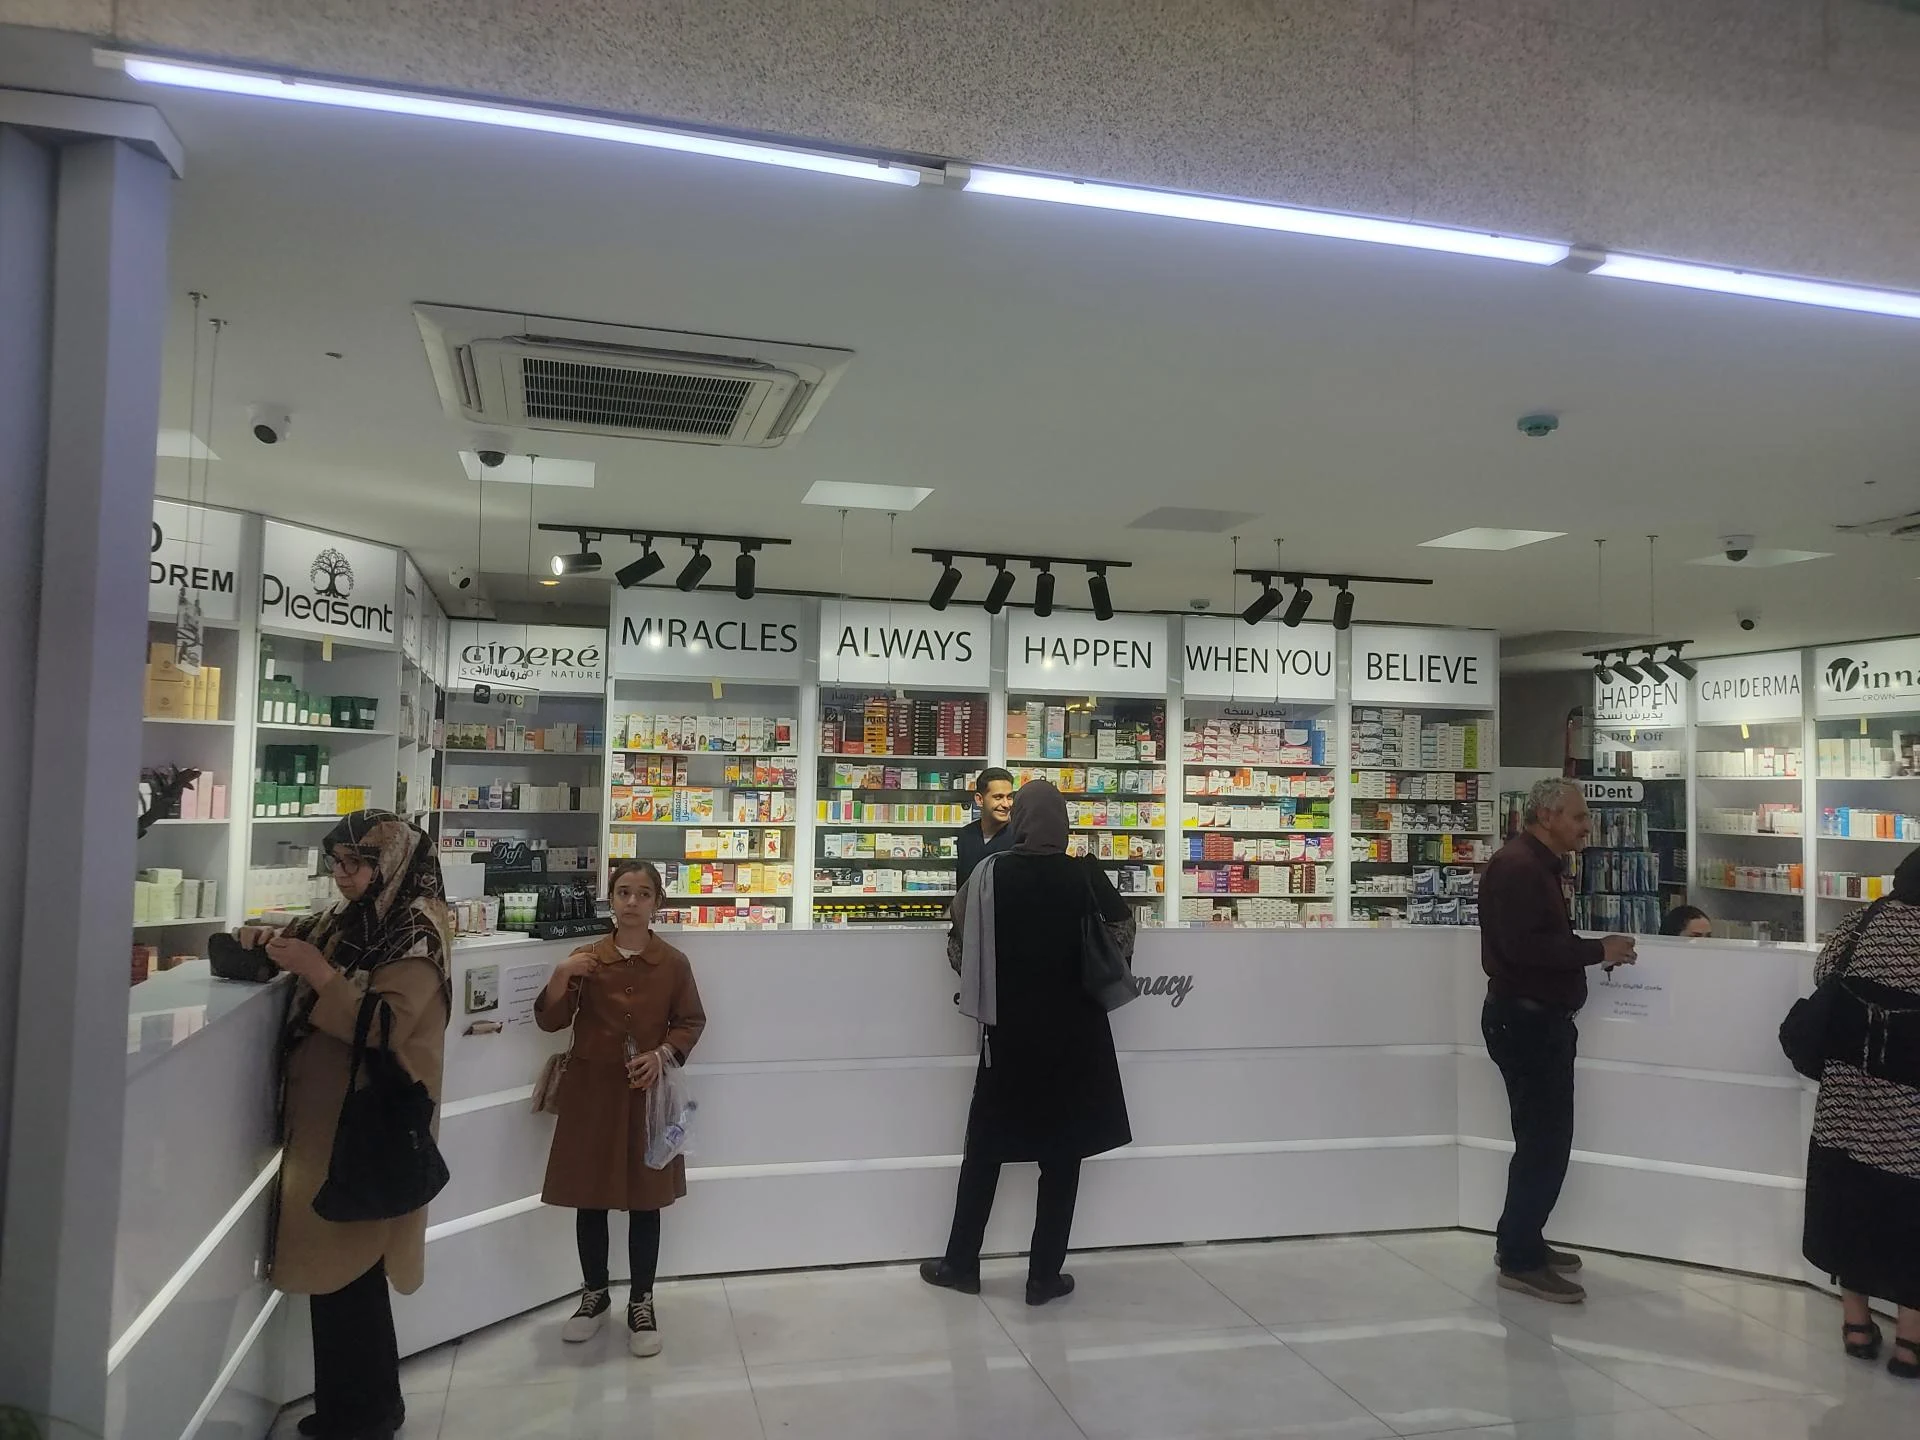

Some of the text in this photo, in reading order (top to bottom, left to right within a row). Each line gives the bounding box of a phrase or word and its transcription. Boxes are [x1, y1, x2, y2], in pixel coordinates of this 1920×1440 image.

[261, 573, 393, 634] Pleasant
[621, 616, 798, 653] MIRACLES
[836, 626, 973, 662] ALWAYS
[1025, 635, 1152, 669] HAPPEN
[1185, 644, 1332, 676] WHEN YOU
[551, 669, 601, 679] NATURE
[1367, 652, 1478, 685] BELIEVE
[1826, 657, 1920, 693] Winn
[496, 692, 523, 706] OTC
[1602, 682, 1678, 709] HAPPEN
[1701, 674, 1801, 701] CAPIDERMA
[1862, 692, 1896, 702] CROWN
[1611, 731, 1664, 743] Drop Off
